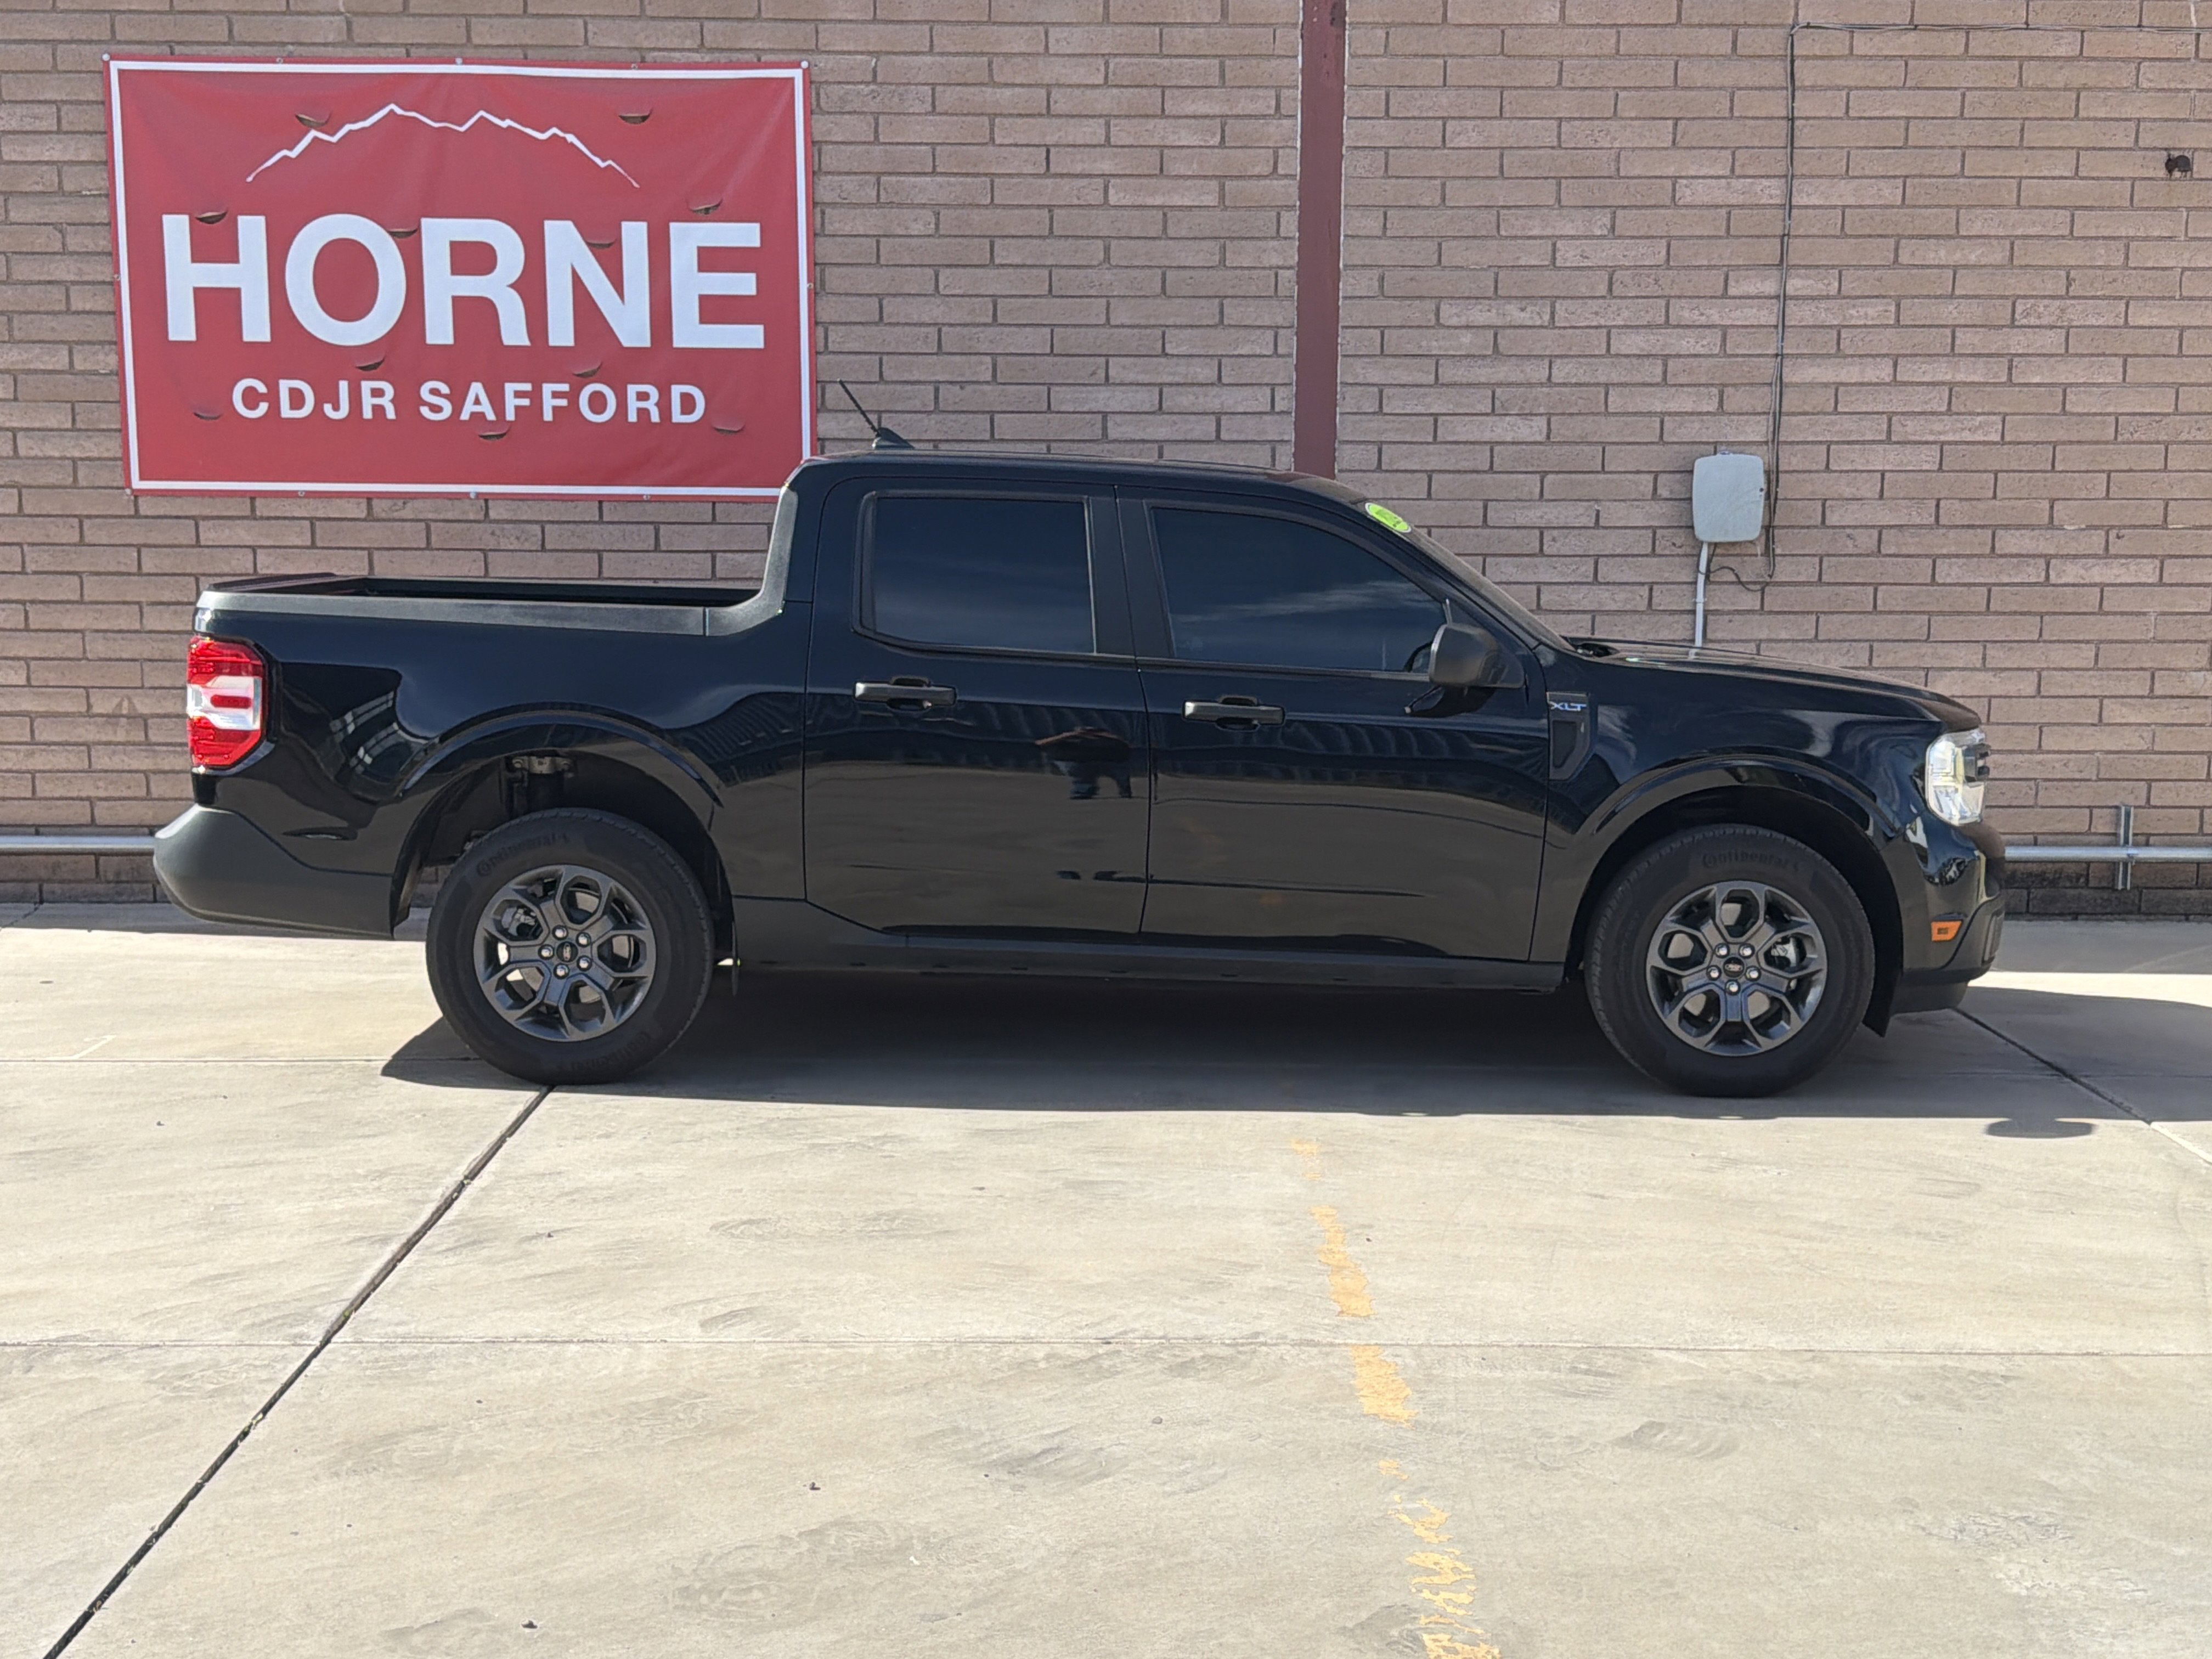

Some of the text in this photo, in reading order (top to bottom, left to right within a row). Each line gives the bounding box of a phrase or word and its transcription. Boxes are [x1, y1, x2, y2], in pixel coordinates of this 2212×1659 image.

[162, 213, 765, 349] HORNE
[232, 377, 707, 424] CDJR SAFFORD
[1548, 701, 1587, 712] XLT
